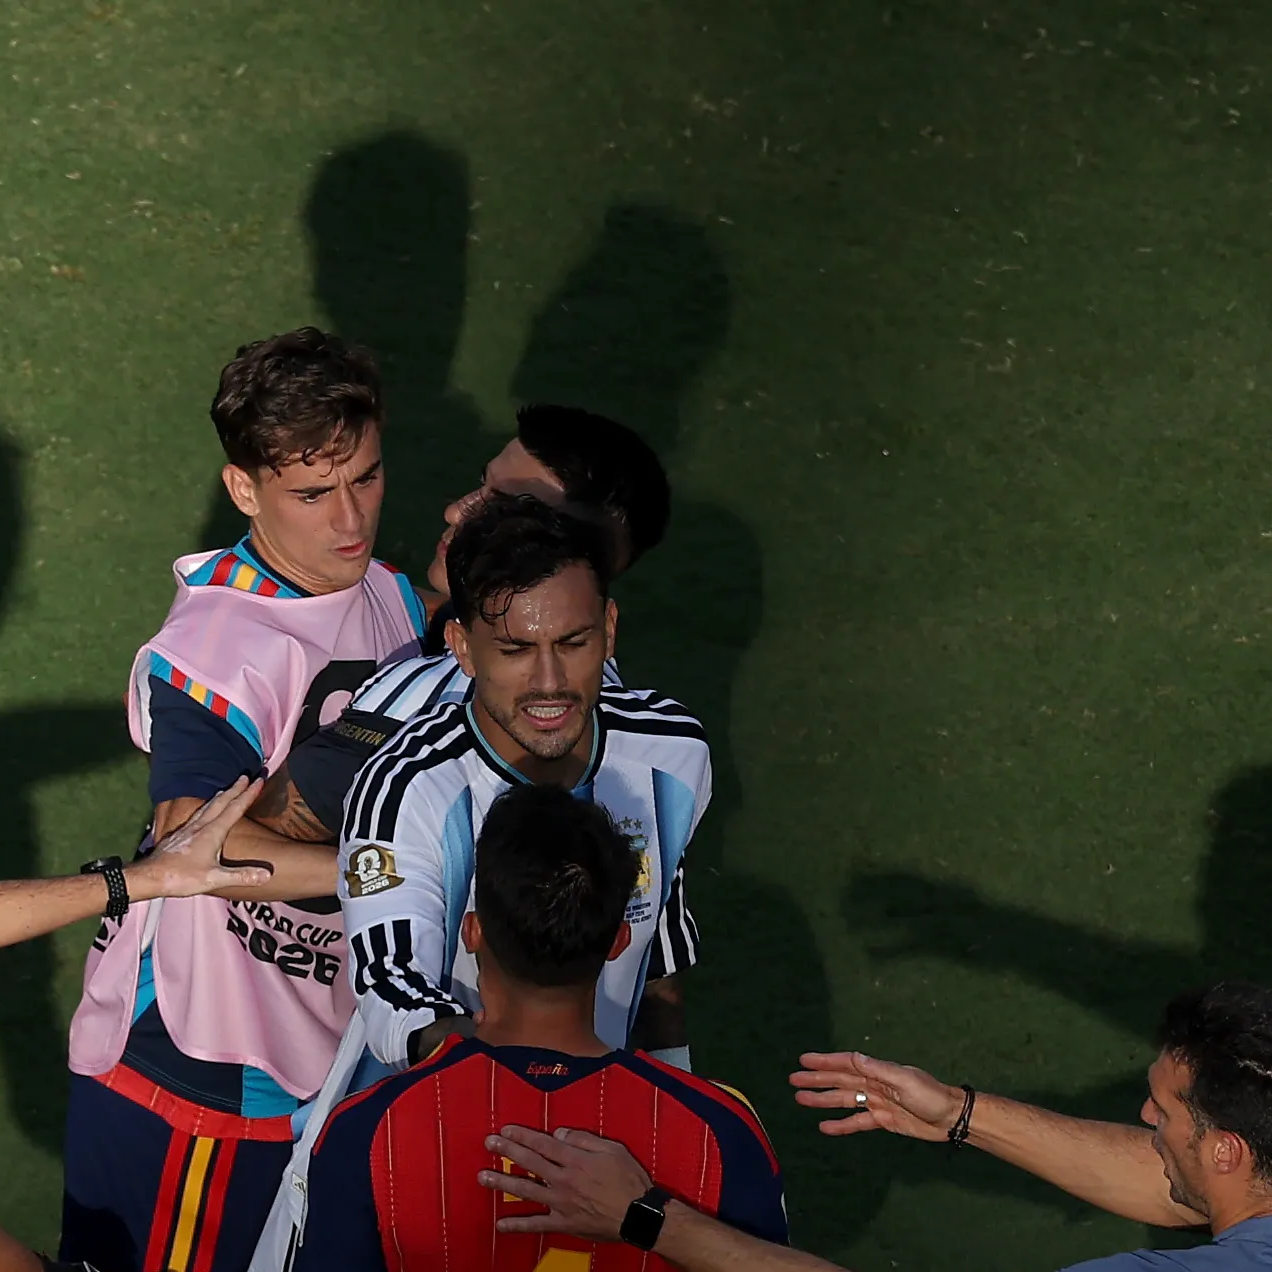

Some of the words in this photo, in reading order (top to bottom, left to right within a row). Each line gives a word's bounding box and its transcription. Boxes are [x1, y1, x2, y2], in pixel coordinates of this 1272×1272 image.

[226, 908, 342, 986] 2026
[296, 923, 343, 948] CUP
[525, 1061, 570, 1079] España
